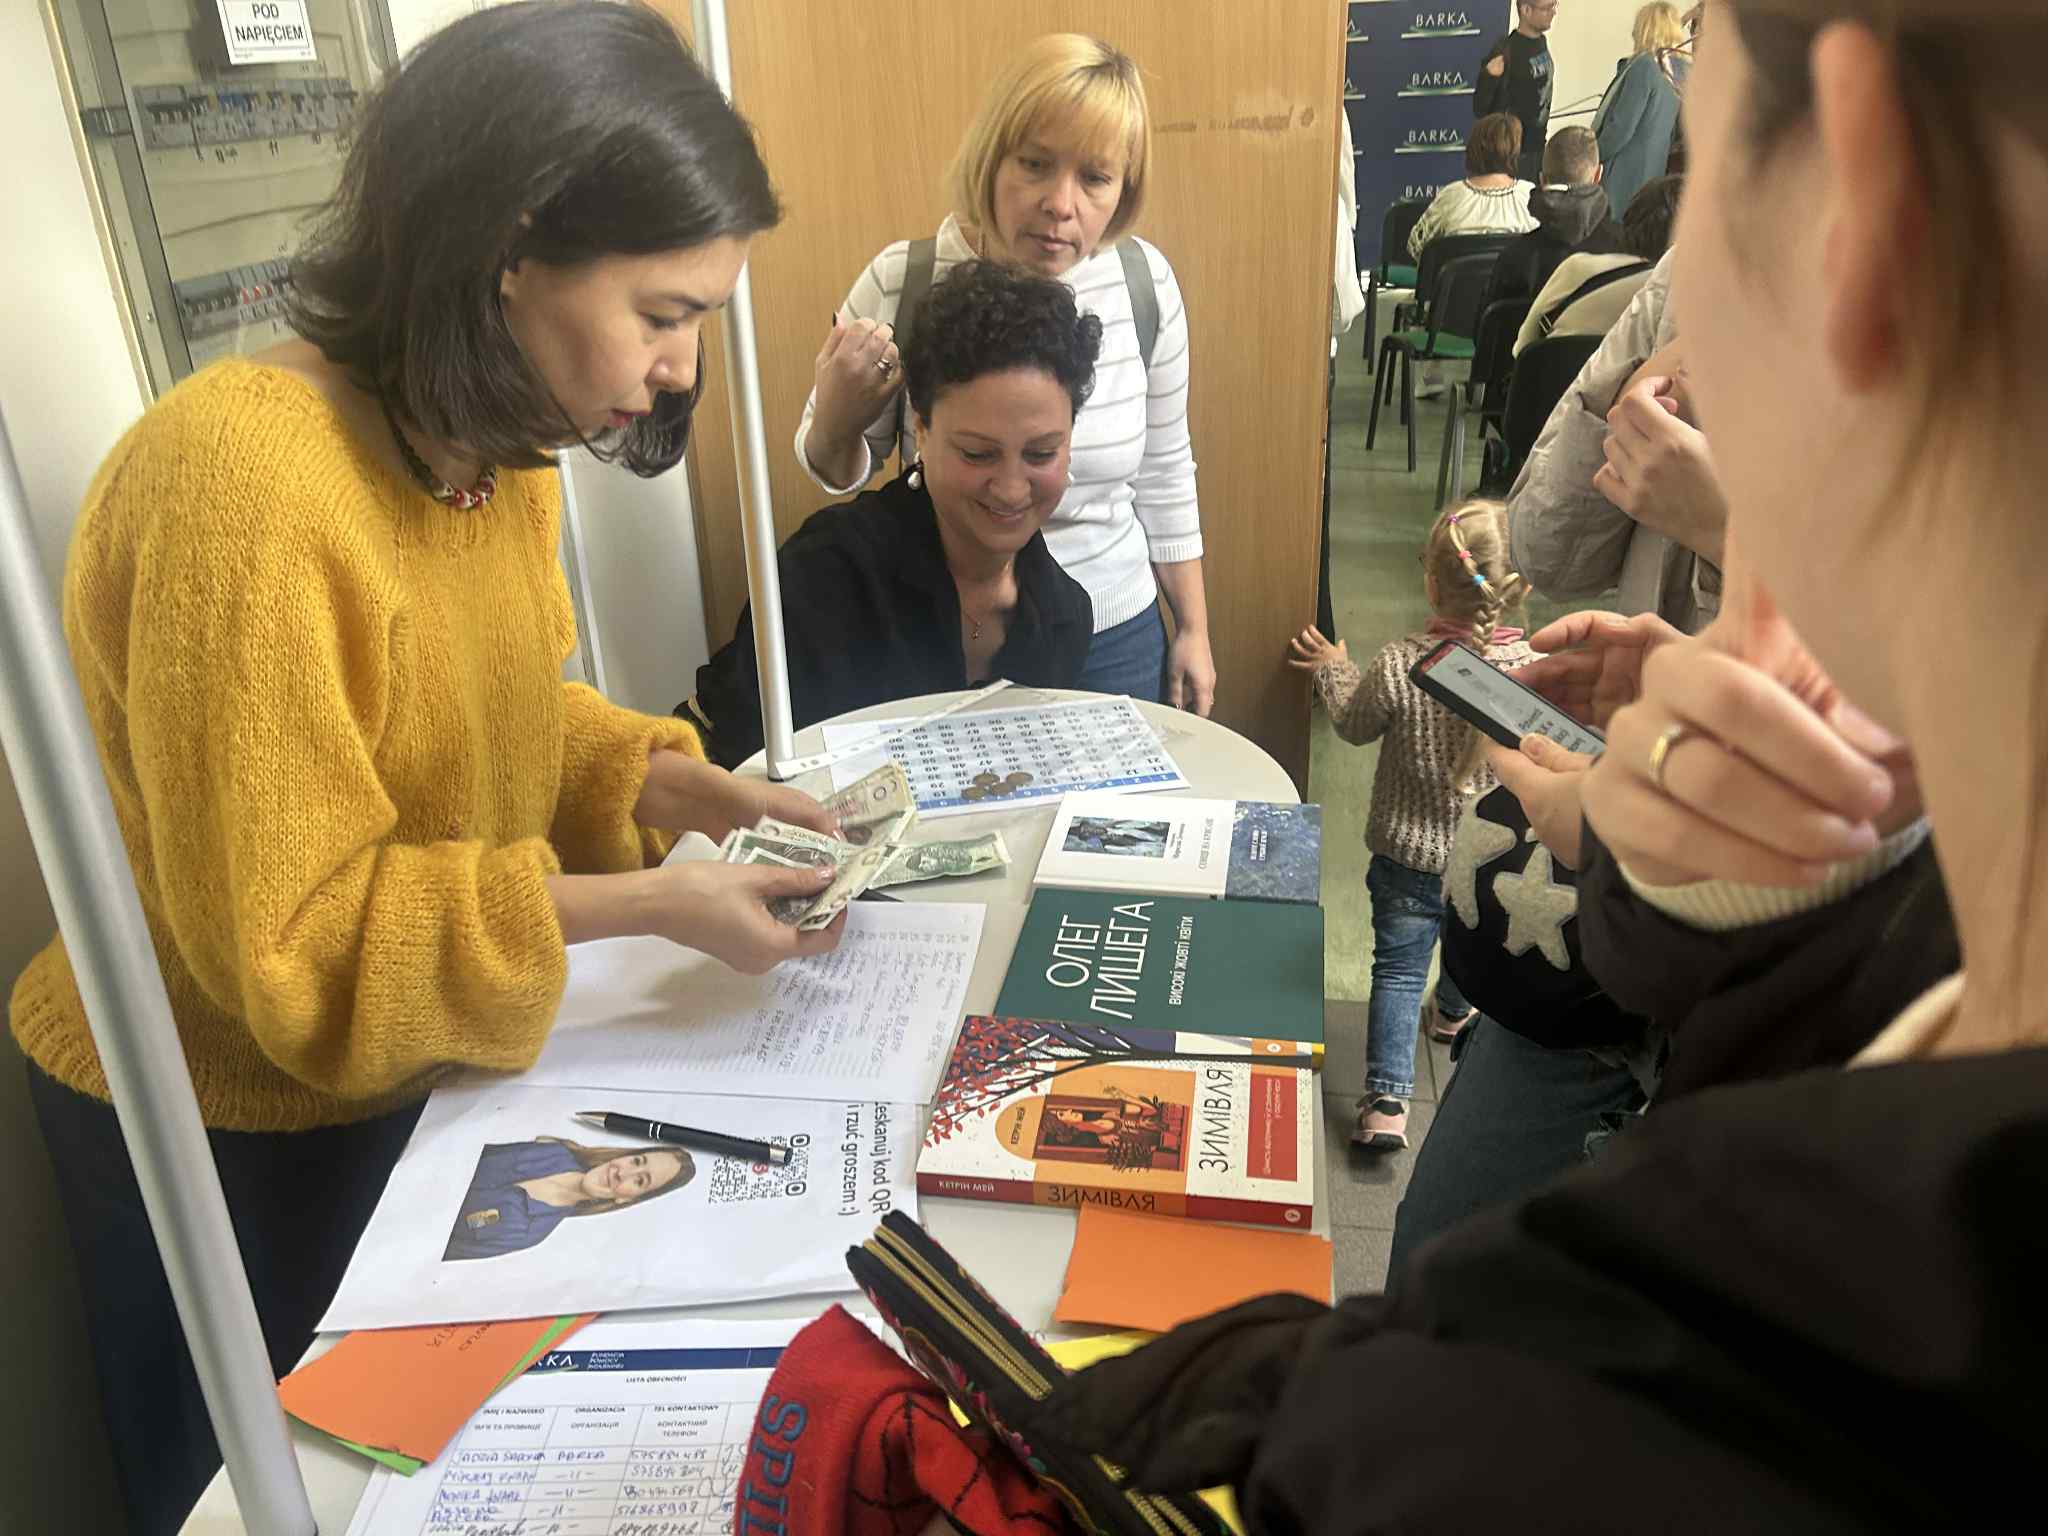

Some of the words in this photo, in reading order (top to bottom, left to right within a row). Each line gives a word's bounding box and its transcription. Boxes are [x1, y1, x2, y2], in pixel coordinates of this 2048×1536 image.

[252, 3, 279, 19] POD
[1416, 12, 1468, 27] BARKA
[235, 24, 304, 46] NAPIĘCIEM
[1412, 72, 1463, 86] BARKA
[1408, 129, 1459, 142] BARKA
[1046, 914, 1101, 988] ОЛЕГ
[1090, 900, 1154, 1020] ЛИШЕГА
[846, 1112, 864, 1140] rzuć
[1199, 1069, 1233, 1173] ЗИМІВЛЯ
[841, 1143, 858, 1203] groszem
[873, 1158, 891, 1186] kod
[868, 1189, 891, 1214] QR
[1047, 1186, 1156, 1211] ЗИМІВЛЯ
